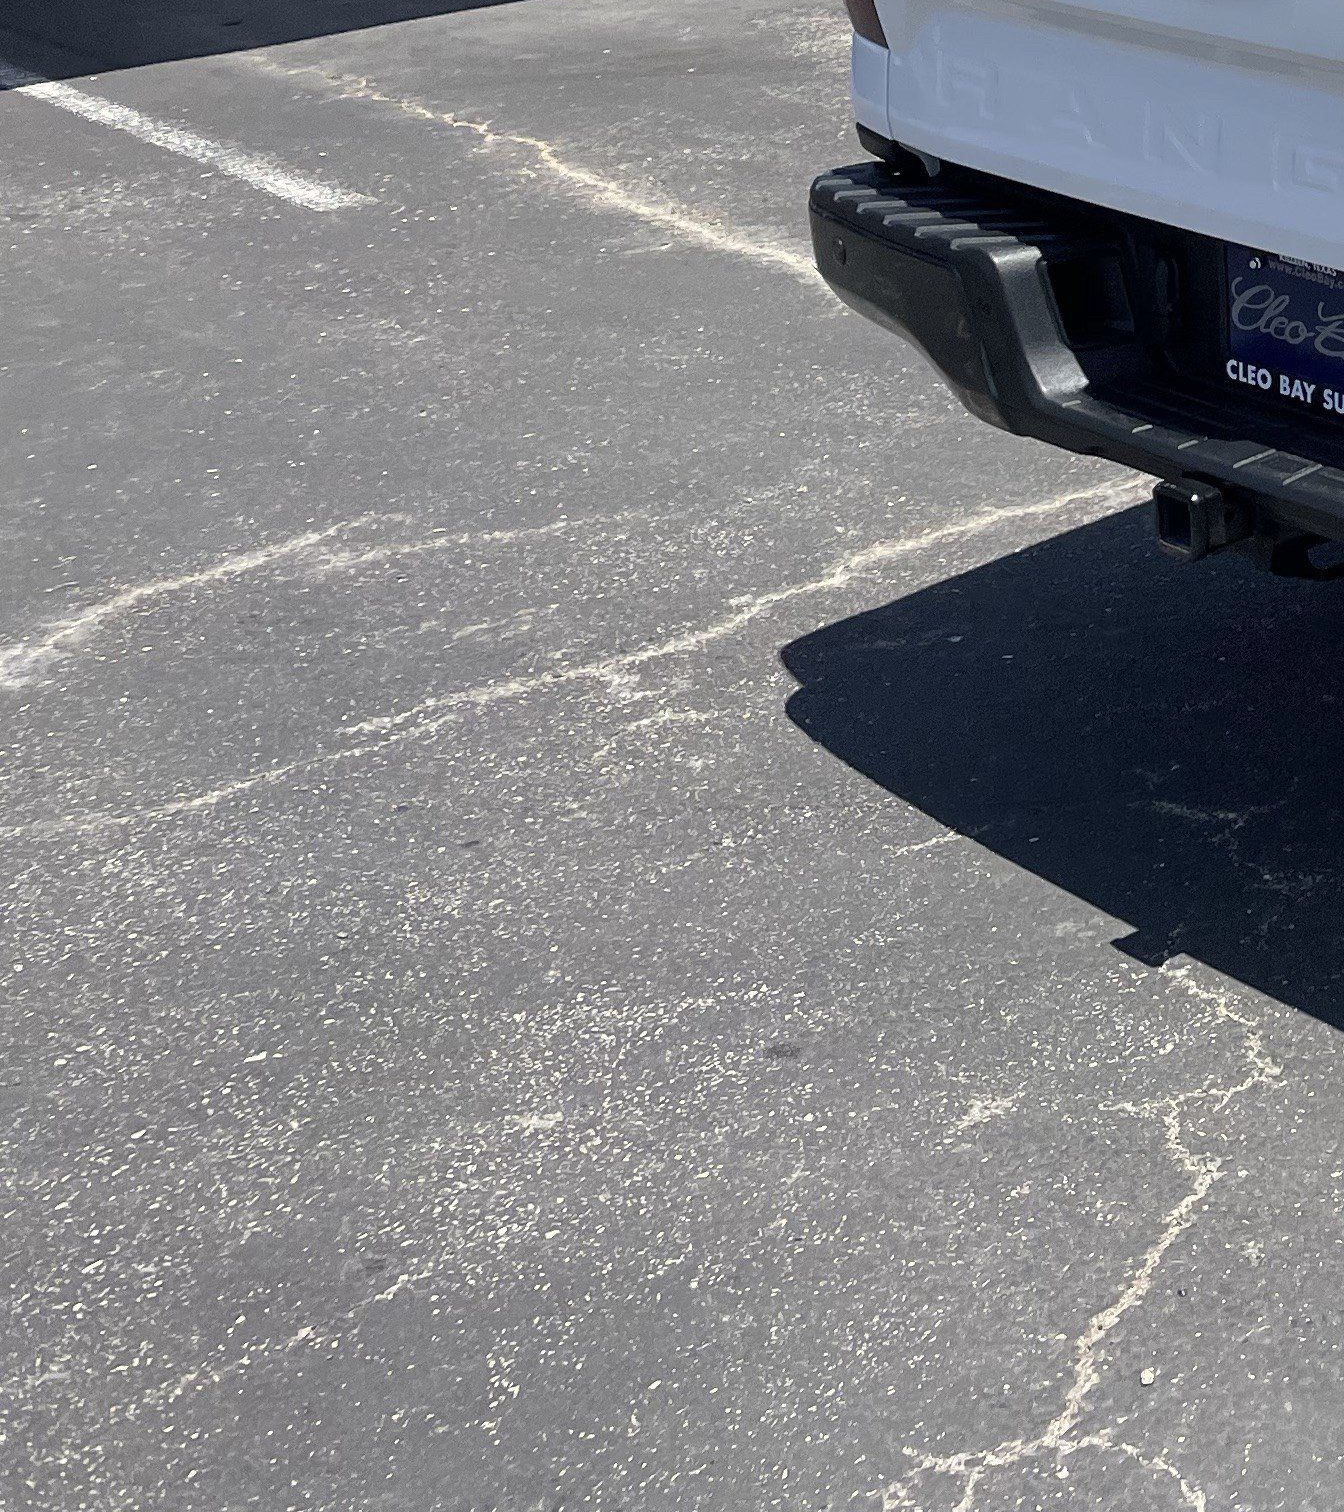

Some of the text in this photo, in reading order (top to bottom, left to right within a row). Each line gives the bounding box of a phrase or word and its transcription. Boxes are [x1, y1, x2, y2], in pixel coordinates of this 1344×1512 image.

[1231, 276, 1312, 345] Cleo
[1226, 358, 1272, 390] CLEO
[1279, 374, 1317, 403] BAY
